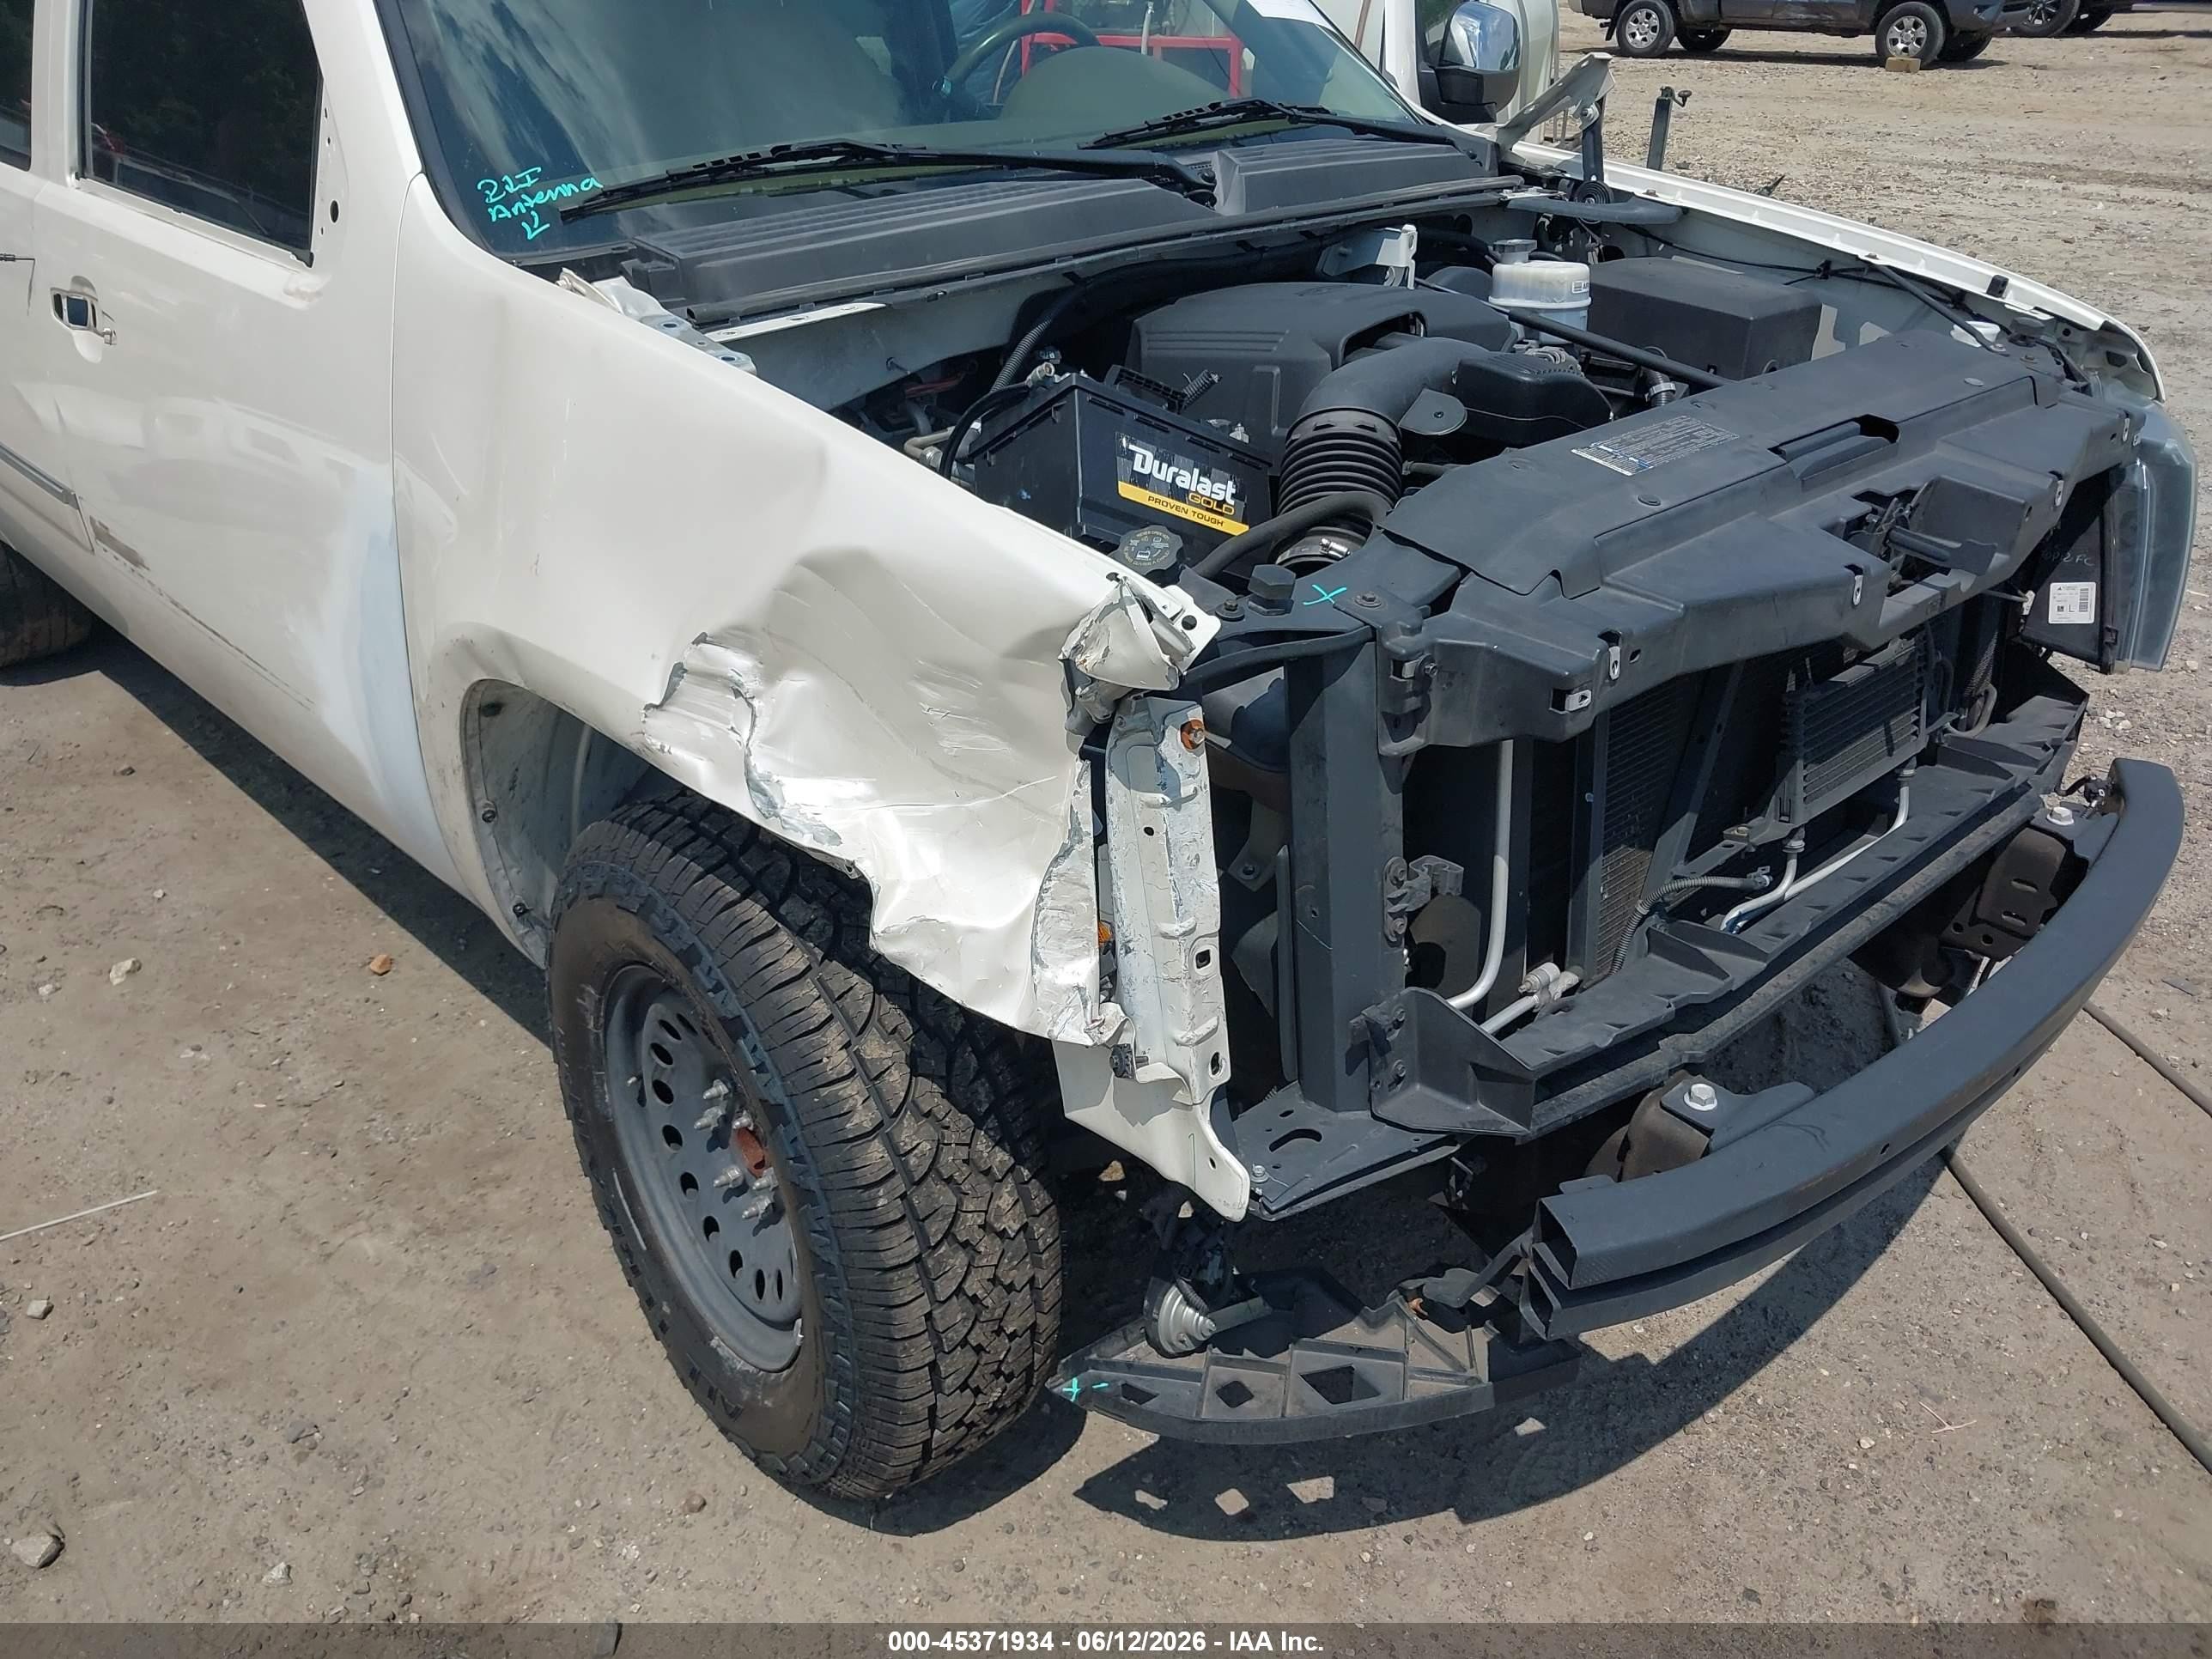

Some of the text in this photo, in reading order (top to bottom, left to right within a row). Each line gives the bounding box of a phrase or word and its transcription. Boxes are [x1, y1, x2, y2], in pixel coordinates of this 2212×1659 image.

[487, 176, 605, 222] Antenna
[1128, 444, 1236, 505] Duralast
[1147, 495, 1224, 527] PROVEN TOUGH
[1188, 492, 1235, 515] GOLD
